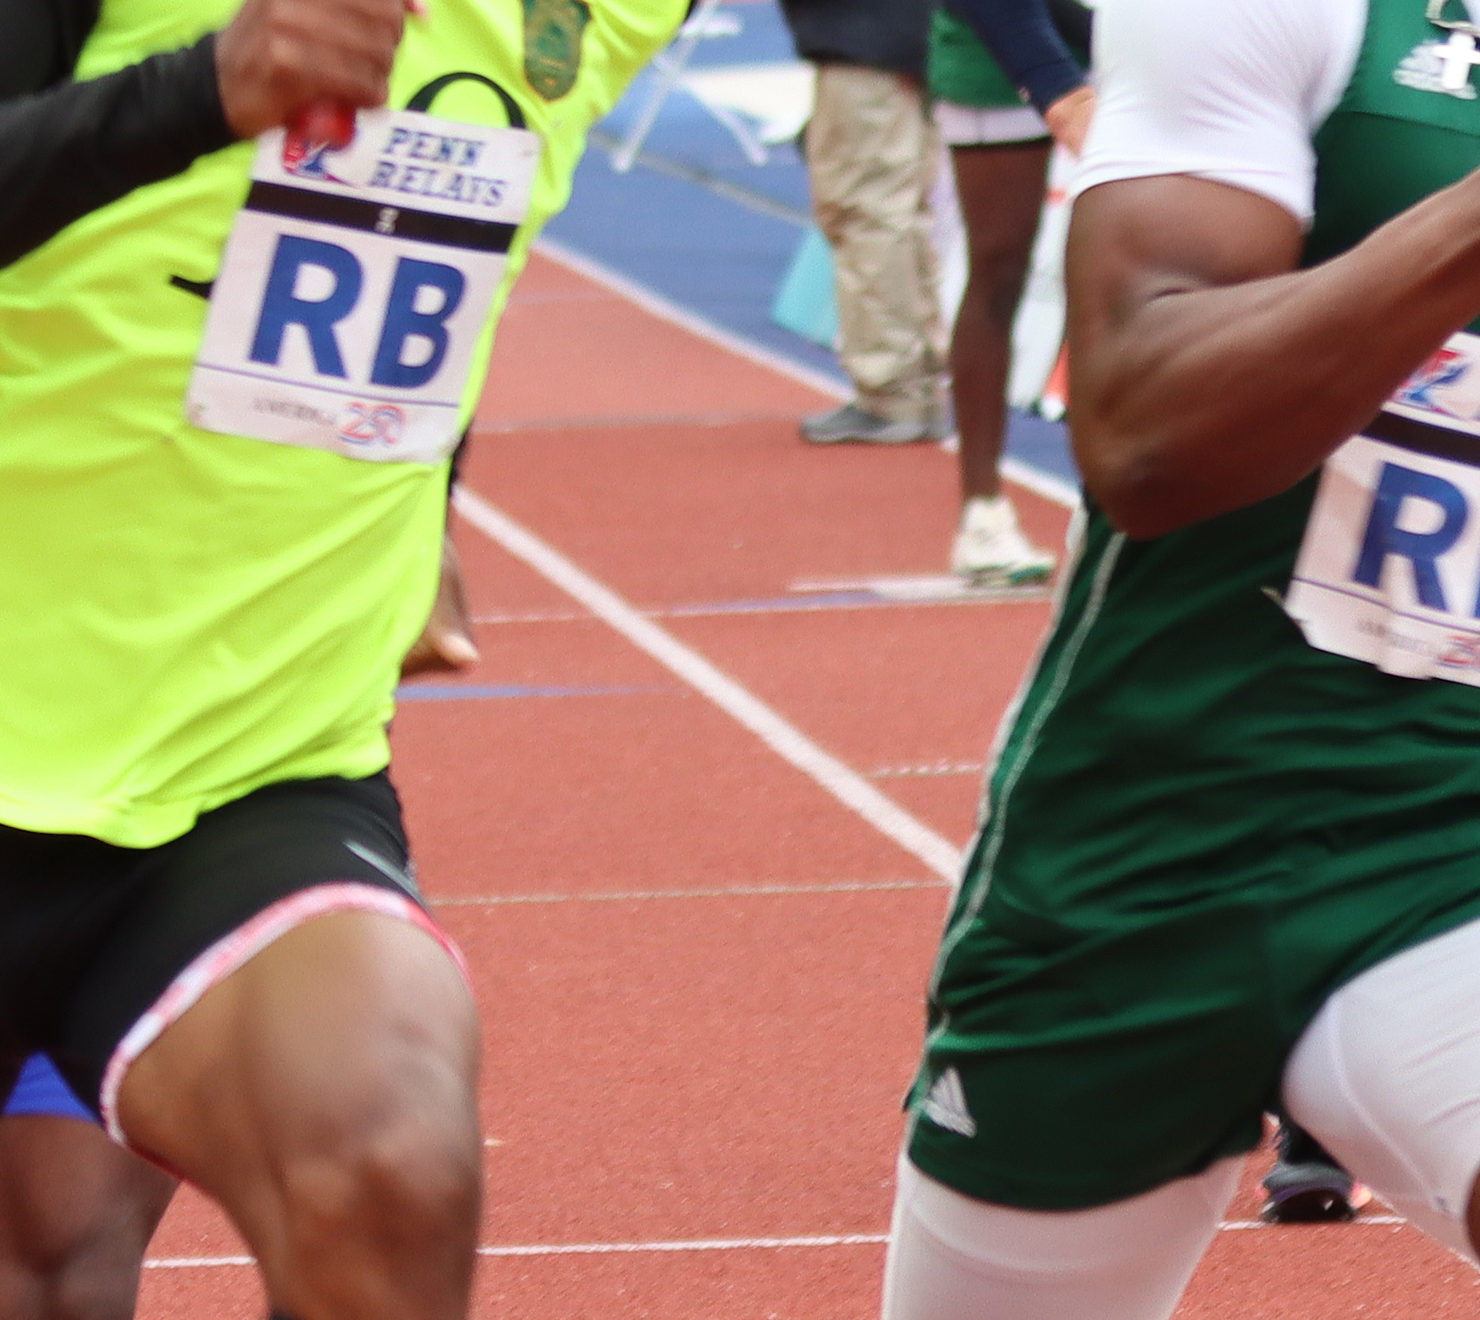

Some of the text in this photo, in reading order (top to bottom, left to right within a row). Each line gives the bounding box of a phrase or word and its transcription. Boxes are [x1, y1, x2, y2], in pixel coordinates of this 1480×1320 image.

[381, 127, 486, 167] PENN
[367, 160, 507, 207] RELAYS
[247, 234, 466, 389] RB
